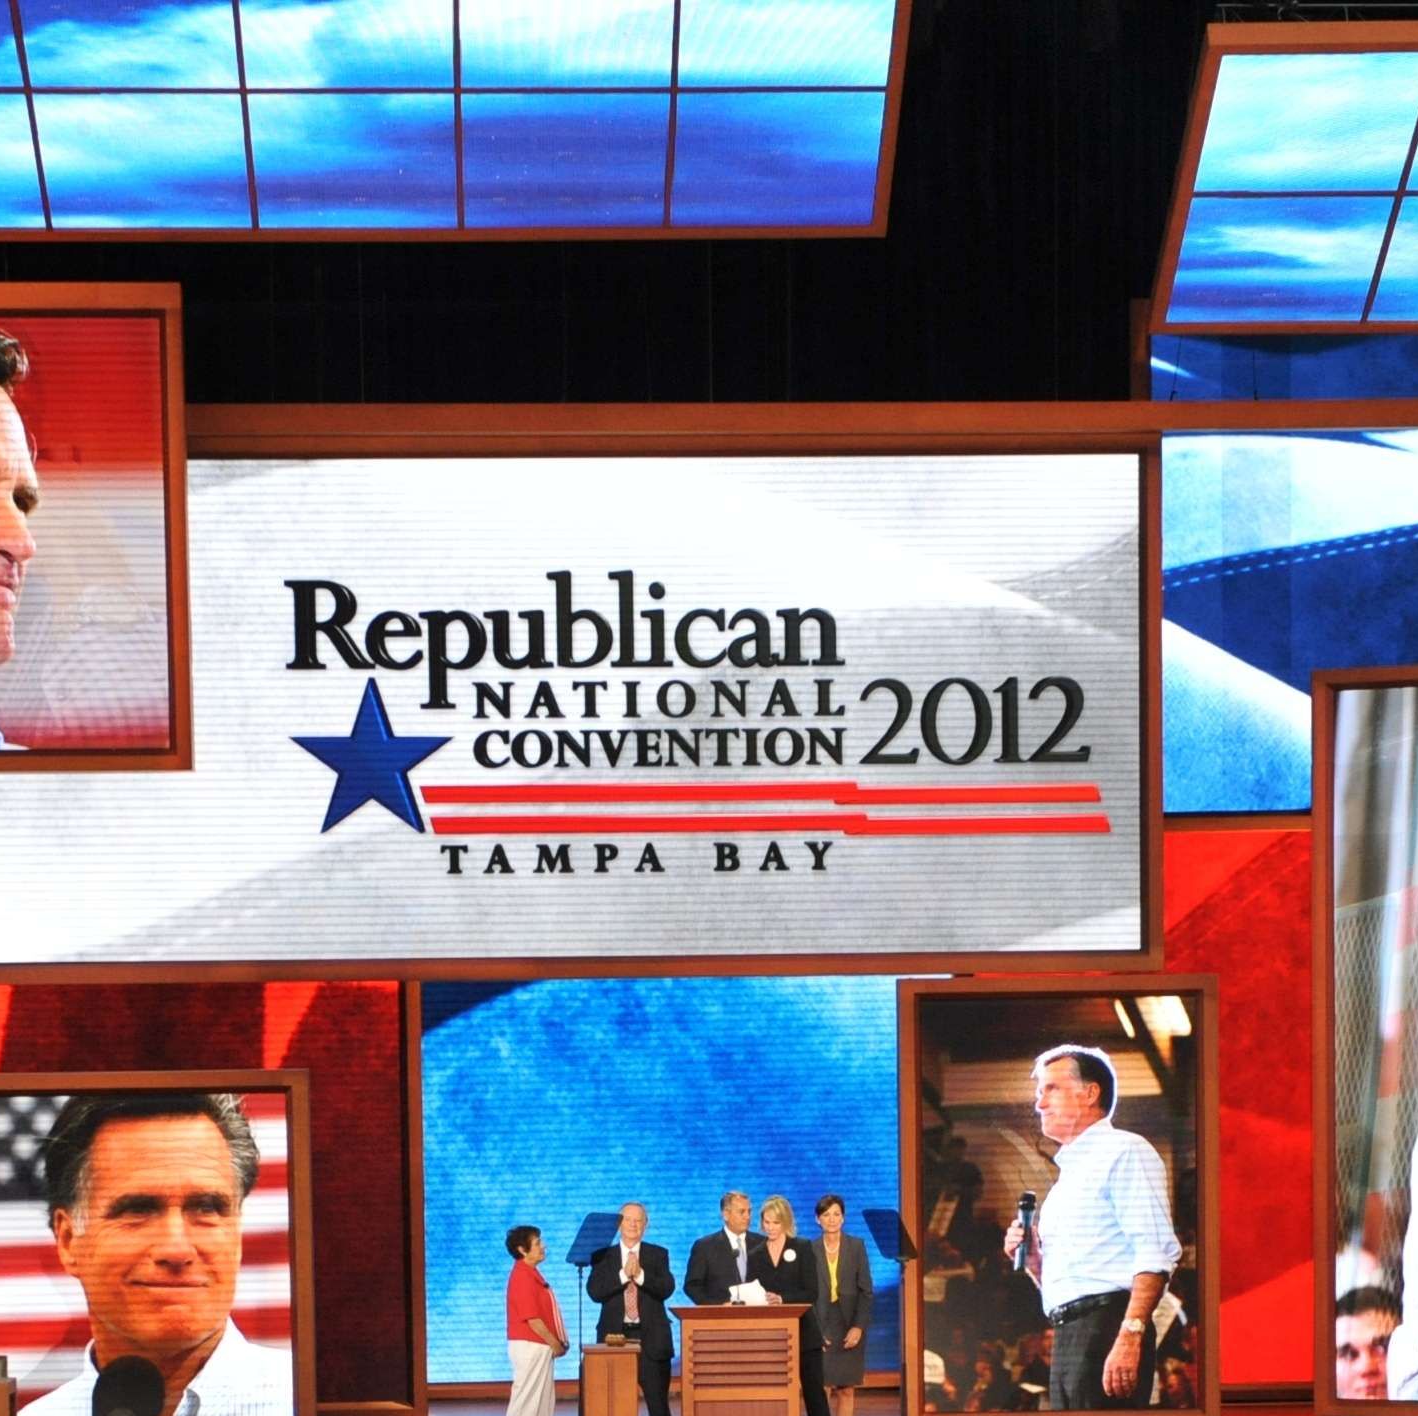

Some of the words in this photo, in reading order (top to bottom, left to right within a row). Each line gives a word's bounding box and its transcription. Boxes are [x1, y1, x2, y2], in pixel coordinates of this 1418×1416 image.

[284, 570, 845, 709] Republican
[473, 679, 847, 720] NATIONAL
[473, 726, 846, 770] CONVENTION
[859, 675, 1091, 767] 2012
[440, 842, 667, 875] TAMPA
[713, 840, 836, 872] BAY
